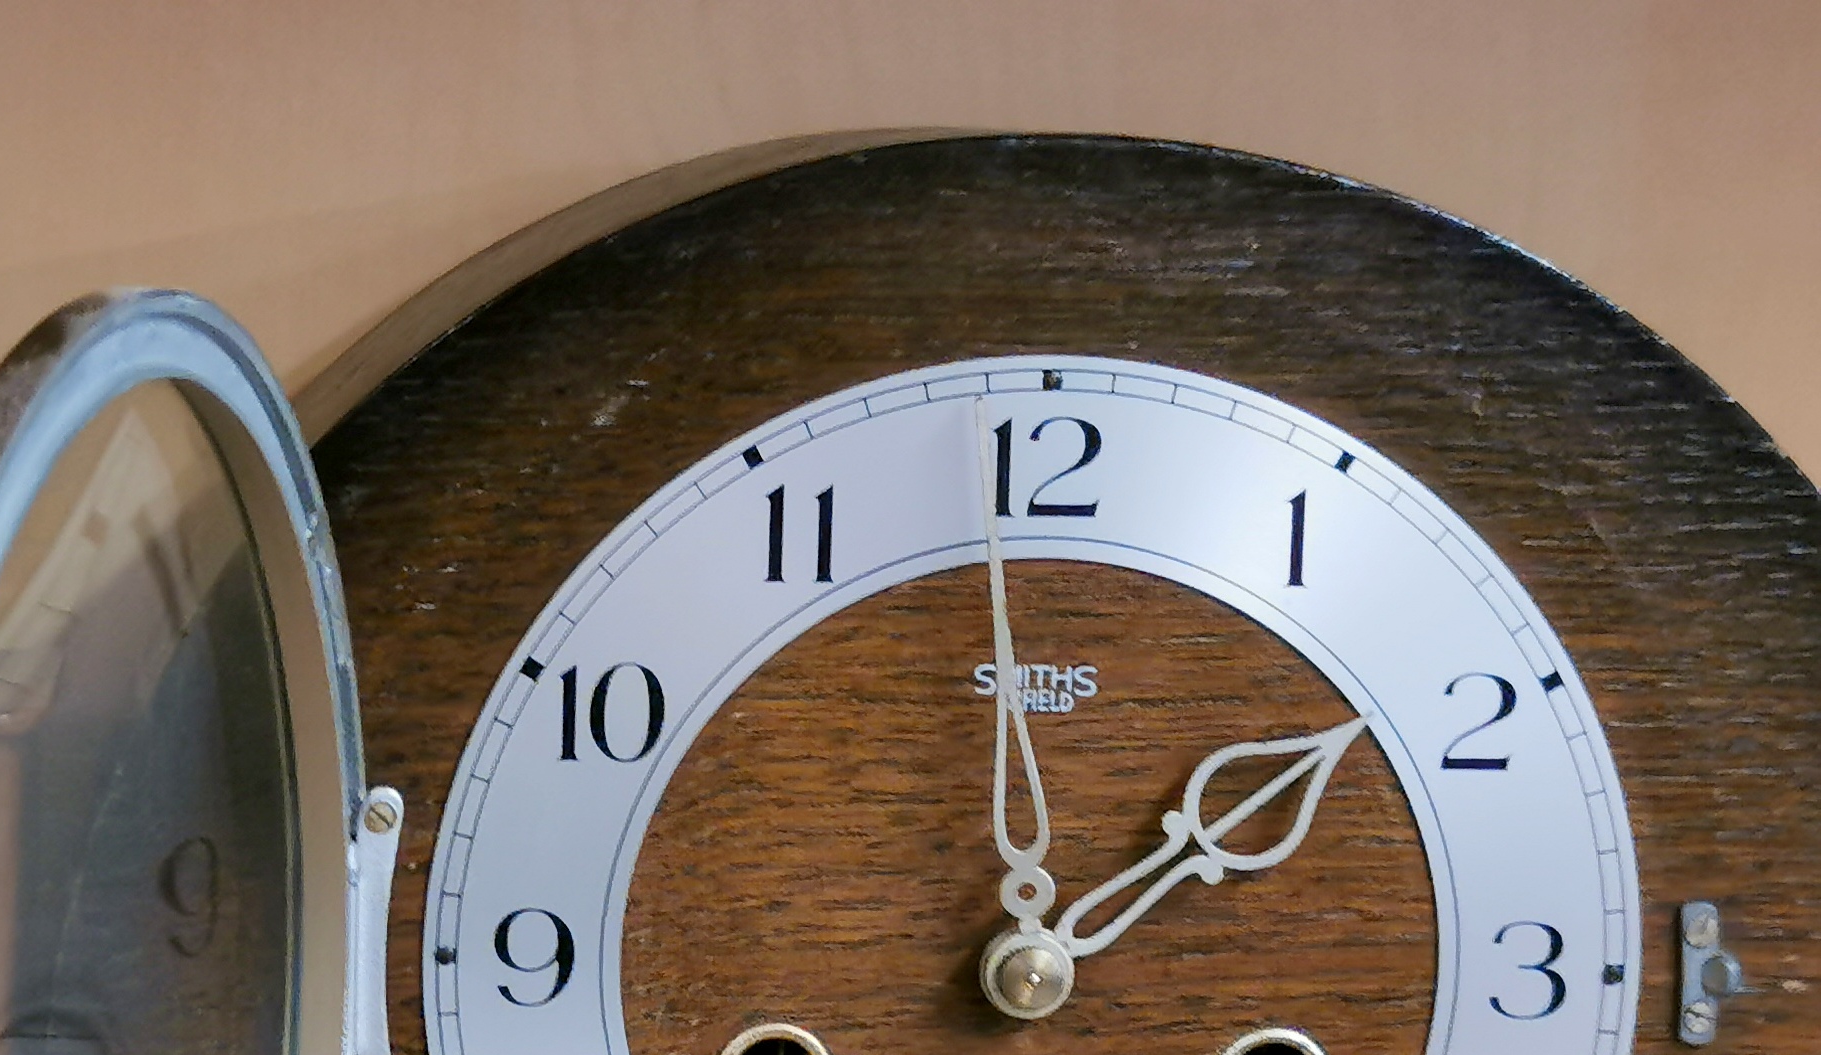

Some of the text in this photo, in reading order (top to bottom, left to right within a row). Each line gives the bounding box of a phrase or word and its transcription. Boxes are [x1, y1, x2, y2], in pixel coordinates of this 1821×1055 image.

[992, 418, 1101, 519] 12
[766, 486, 834, 582] 11
[1286, 489, 1307, 588] 1
[558, 663, 665, 763] 10
[1442, 673, 1516, 771] 2
[493, 909, 574, 1007] 9
[1489, 922, 1566, 1021] 3
